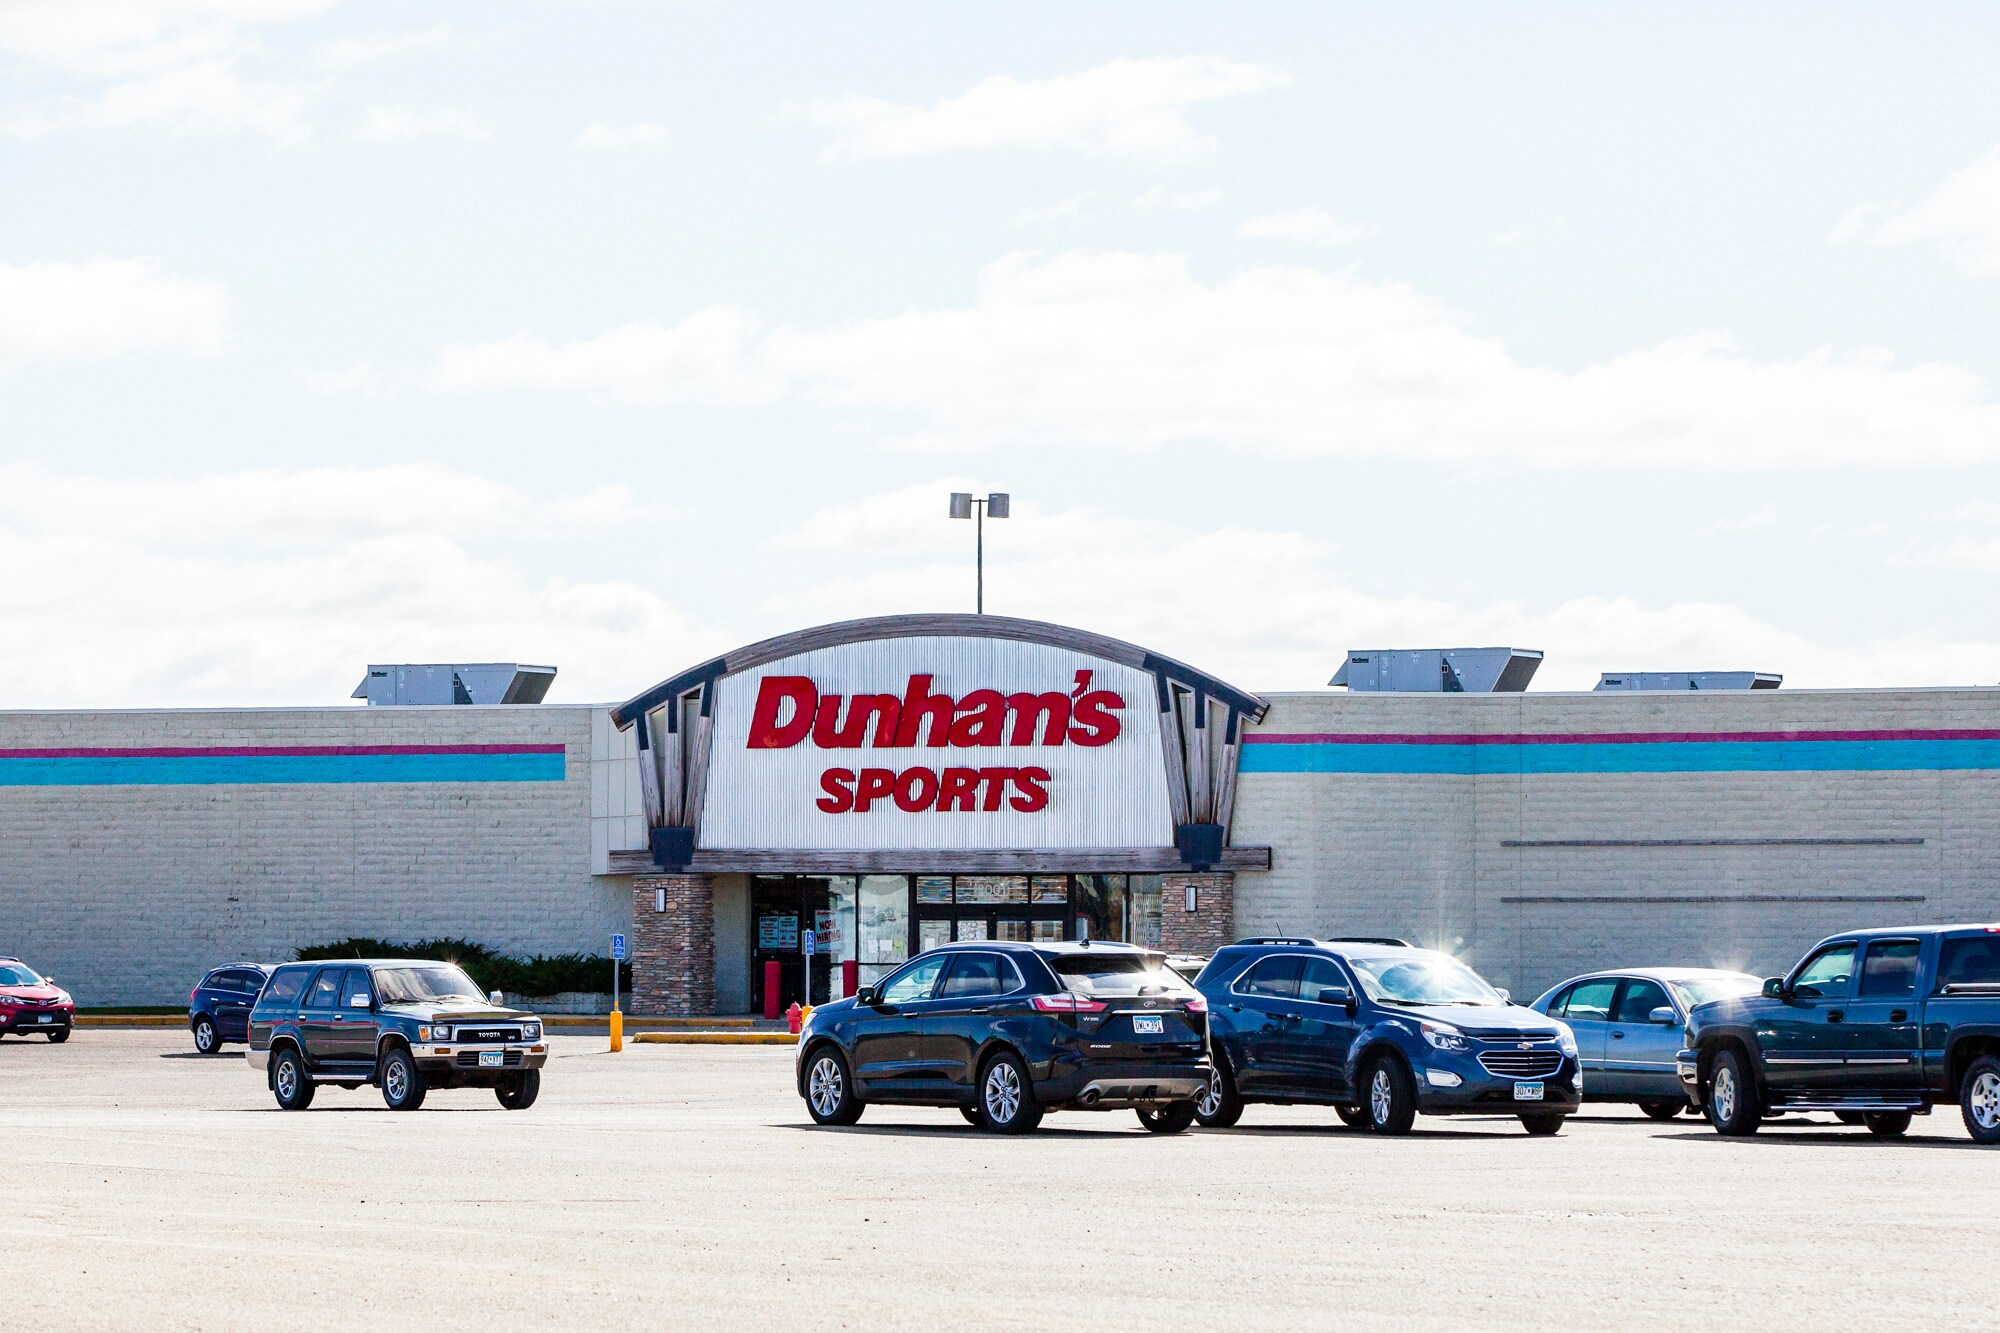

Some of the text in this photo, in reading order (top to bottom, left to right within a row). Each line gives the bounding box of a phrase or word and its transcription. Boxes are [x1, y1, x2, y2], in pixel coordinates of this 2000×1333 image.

[746, 669, 1126, 749] Dunham's
[815, 766, 1051, 814] SPORTS
[818, 919, 837, 931] NOW
